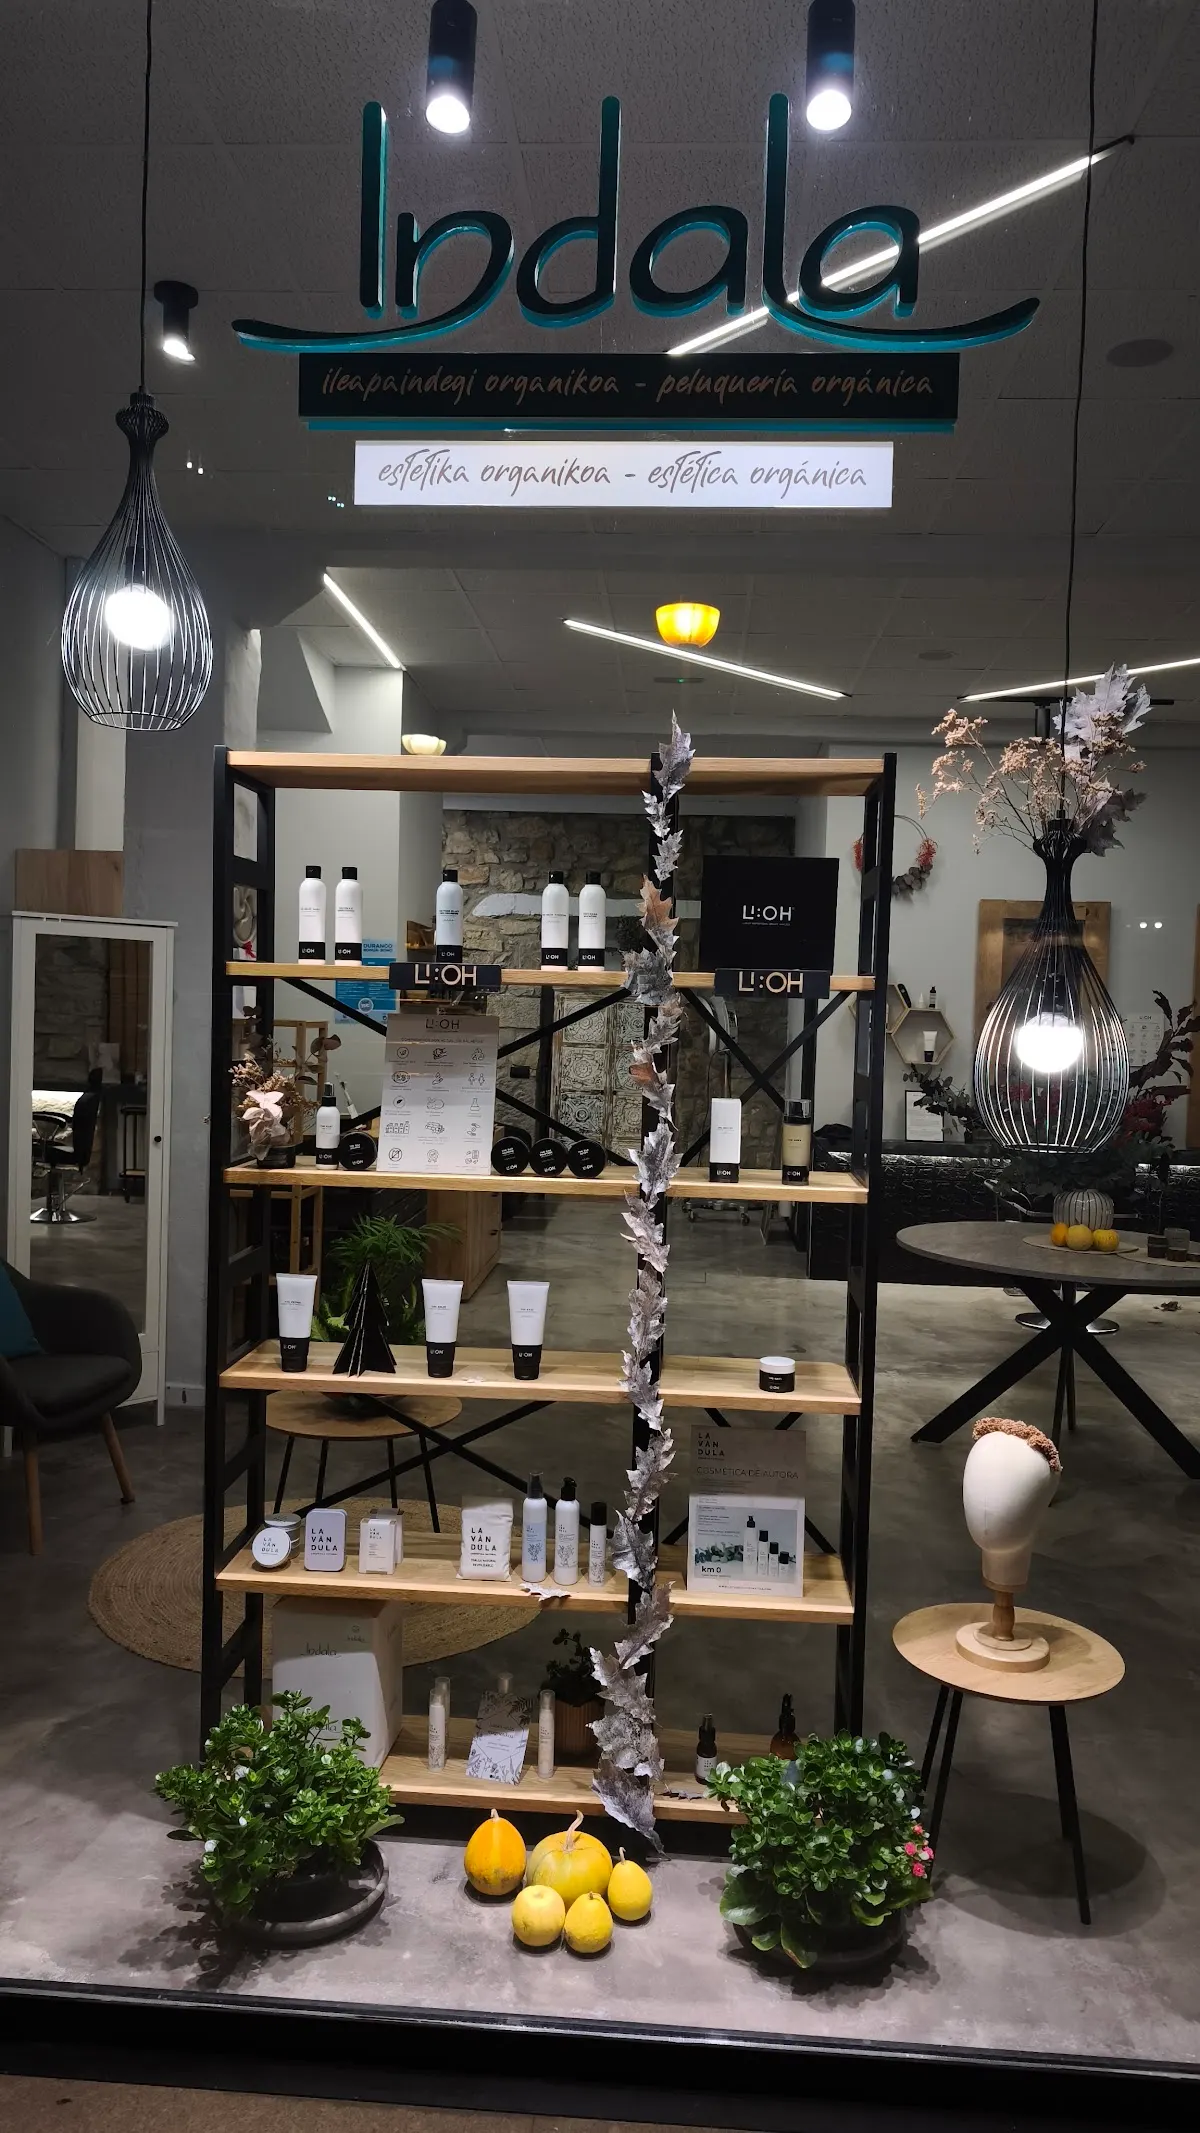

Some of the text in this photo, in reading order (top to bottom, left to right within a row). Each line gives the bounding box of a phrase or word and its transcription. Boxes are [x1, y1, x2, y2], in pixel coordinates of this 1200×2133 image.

[231, 91, 1040, 352] Indala
[321, 366, 477, 405] ileapaindegi
[484, 367, 619, 405] organikoa
[655, 368, 798, 405] peluquería
[811, 368, 934, 406] orgánica
[377, 448, 469, 491] estetika
[480, 457, 611, 497] organikoa
[647, 450, 738, 494] estética
[749, 460, 867, 499] orgánica
[470, 1543, 497, 1551] DULA
[701, 1565, 715, 1573] km
